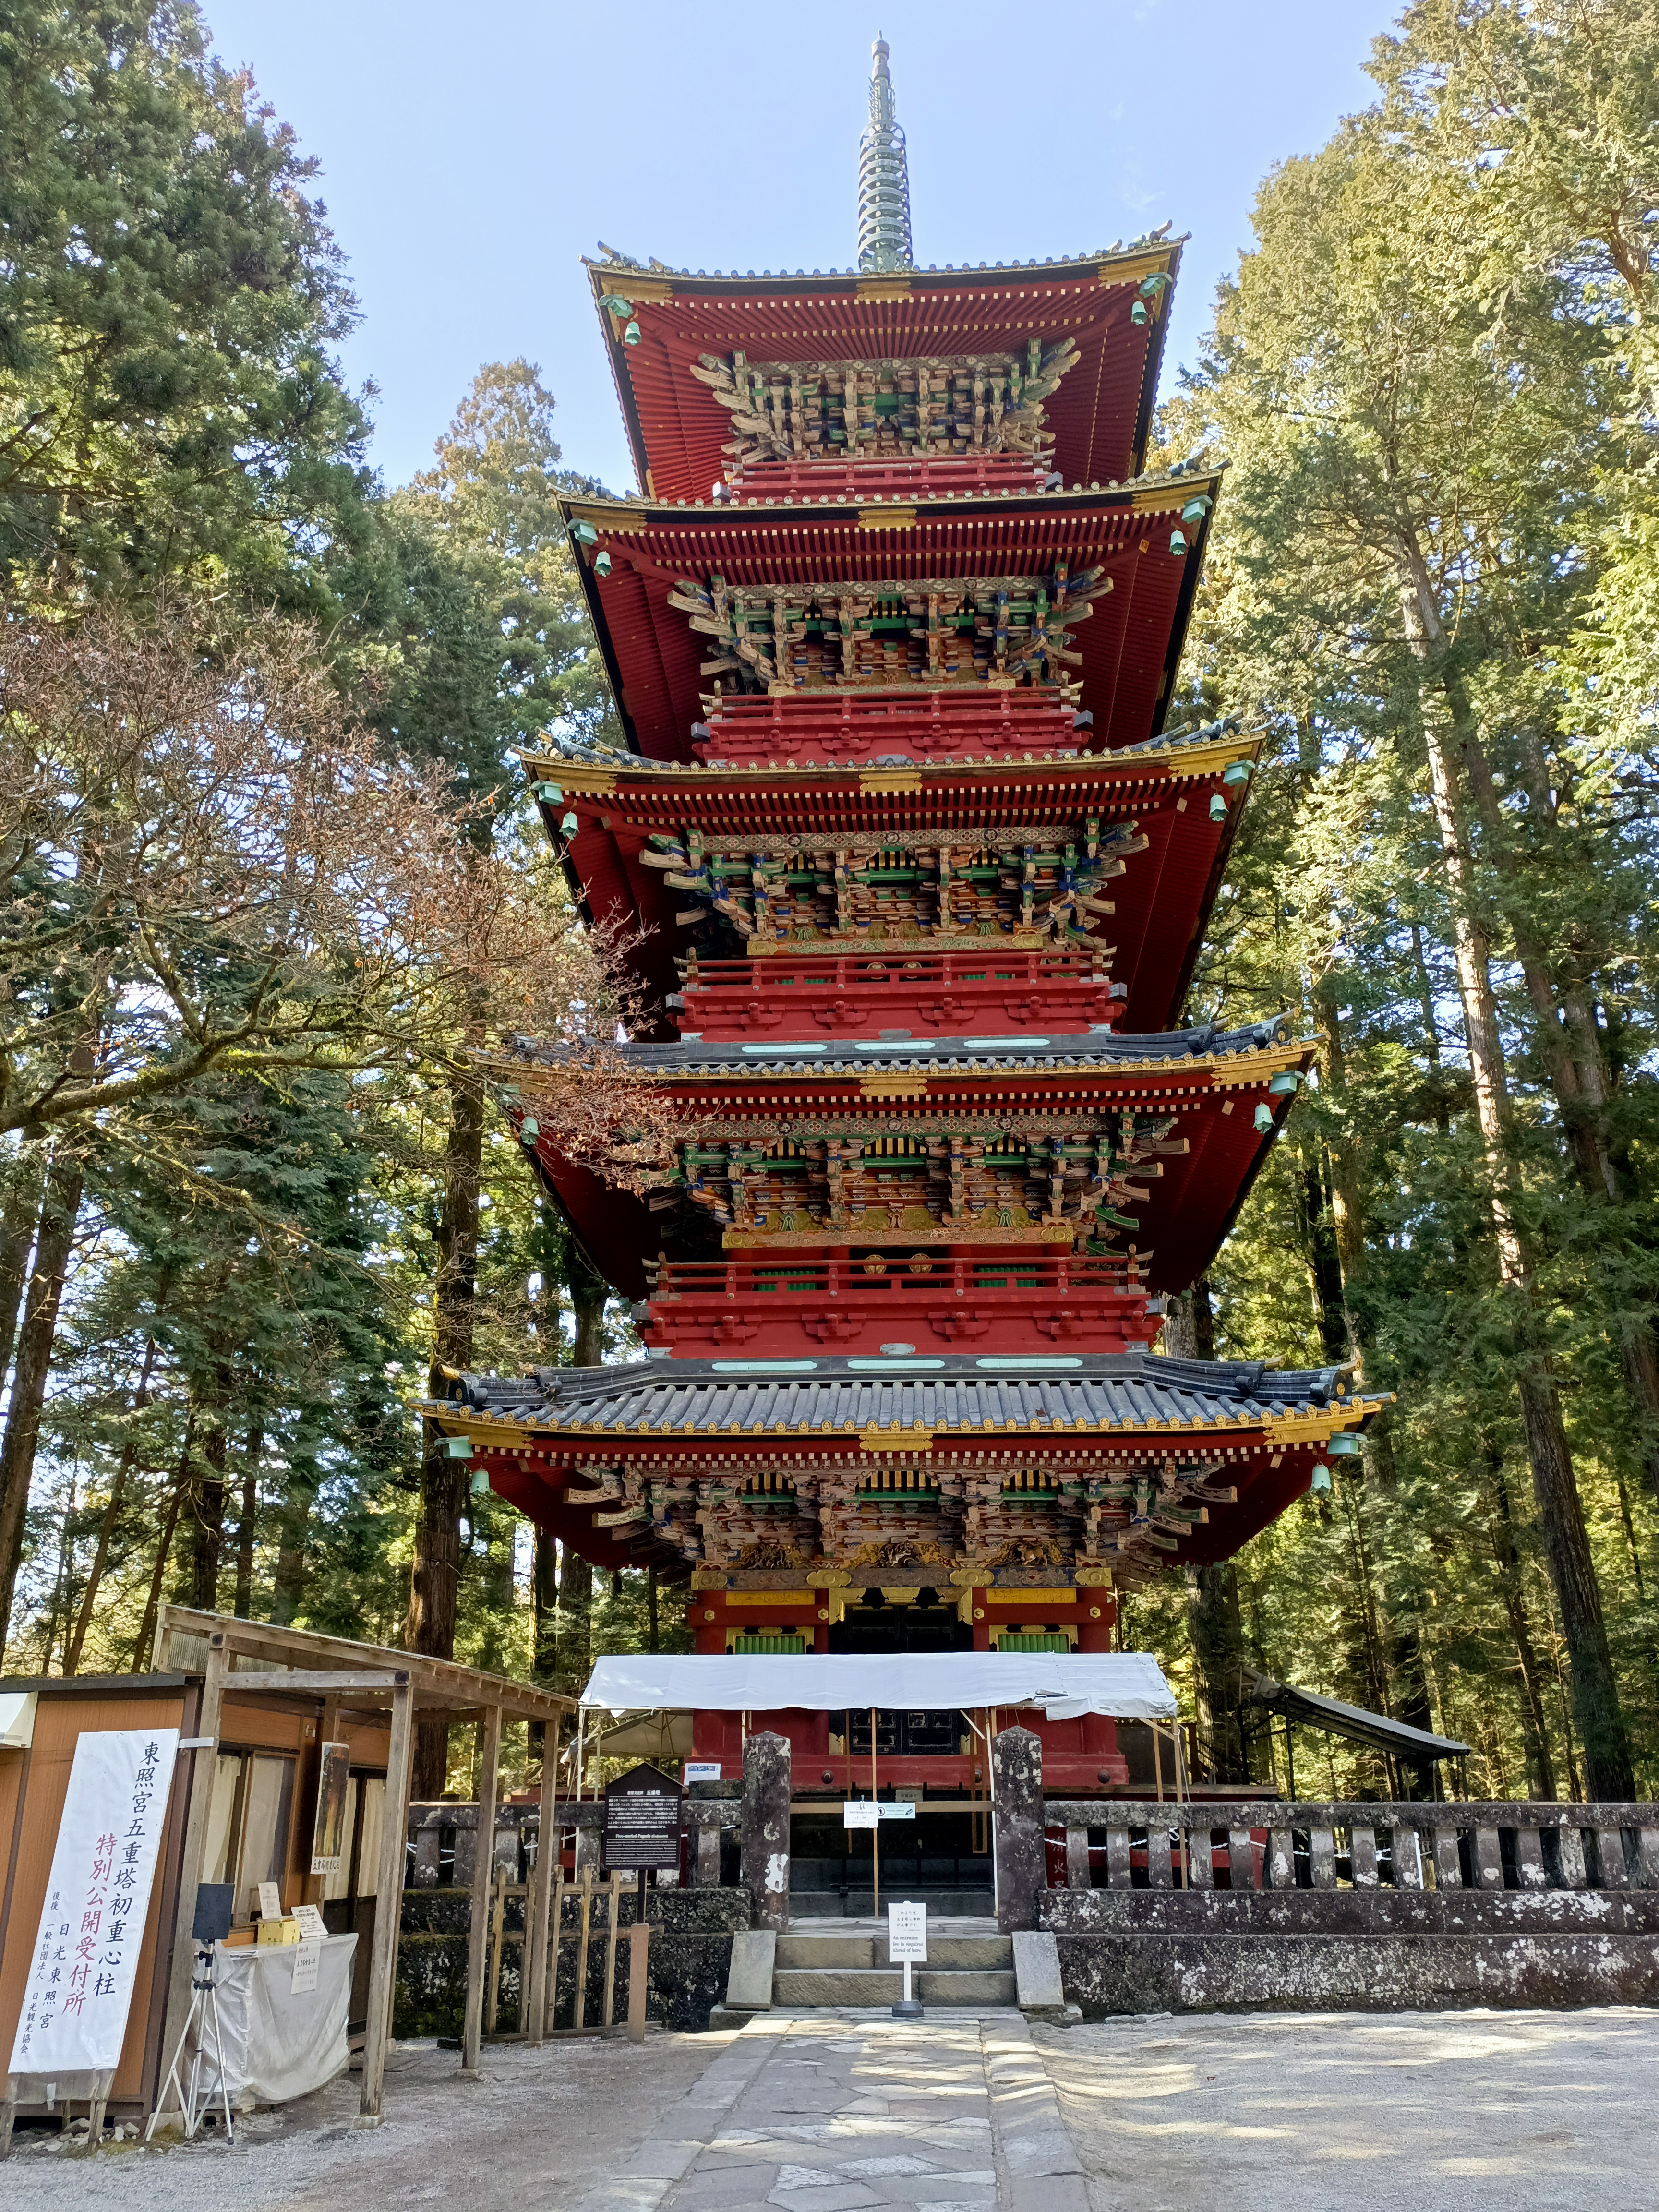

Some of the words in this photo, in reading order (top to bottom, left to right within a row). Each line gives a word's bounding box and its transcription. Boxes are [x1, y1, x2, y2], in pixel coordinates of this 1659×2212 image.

[50, 1892, 60, 1911] 後援
[93, 1741, 160, 1996] 東照宮五重塔初重心柱
[35, 1924, 55, 1980] 一般社団法人
[61, 1833, 118, 2016] 特別公開受付所
[40, 1923, 70, 2029] 日光東照宮
[20, 1992, 38, 2054] 日光観光協会
